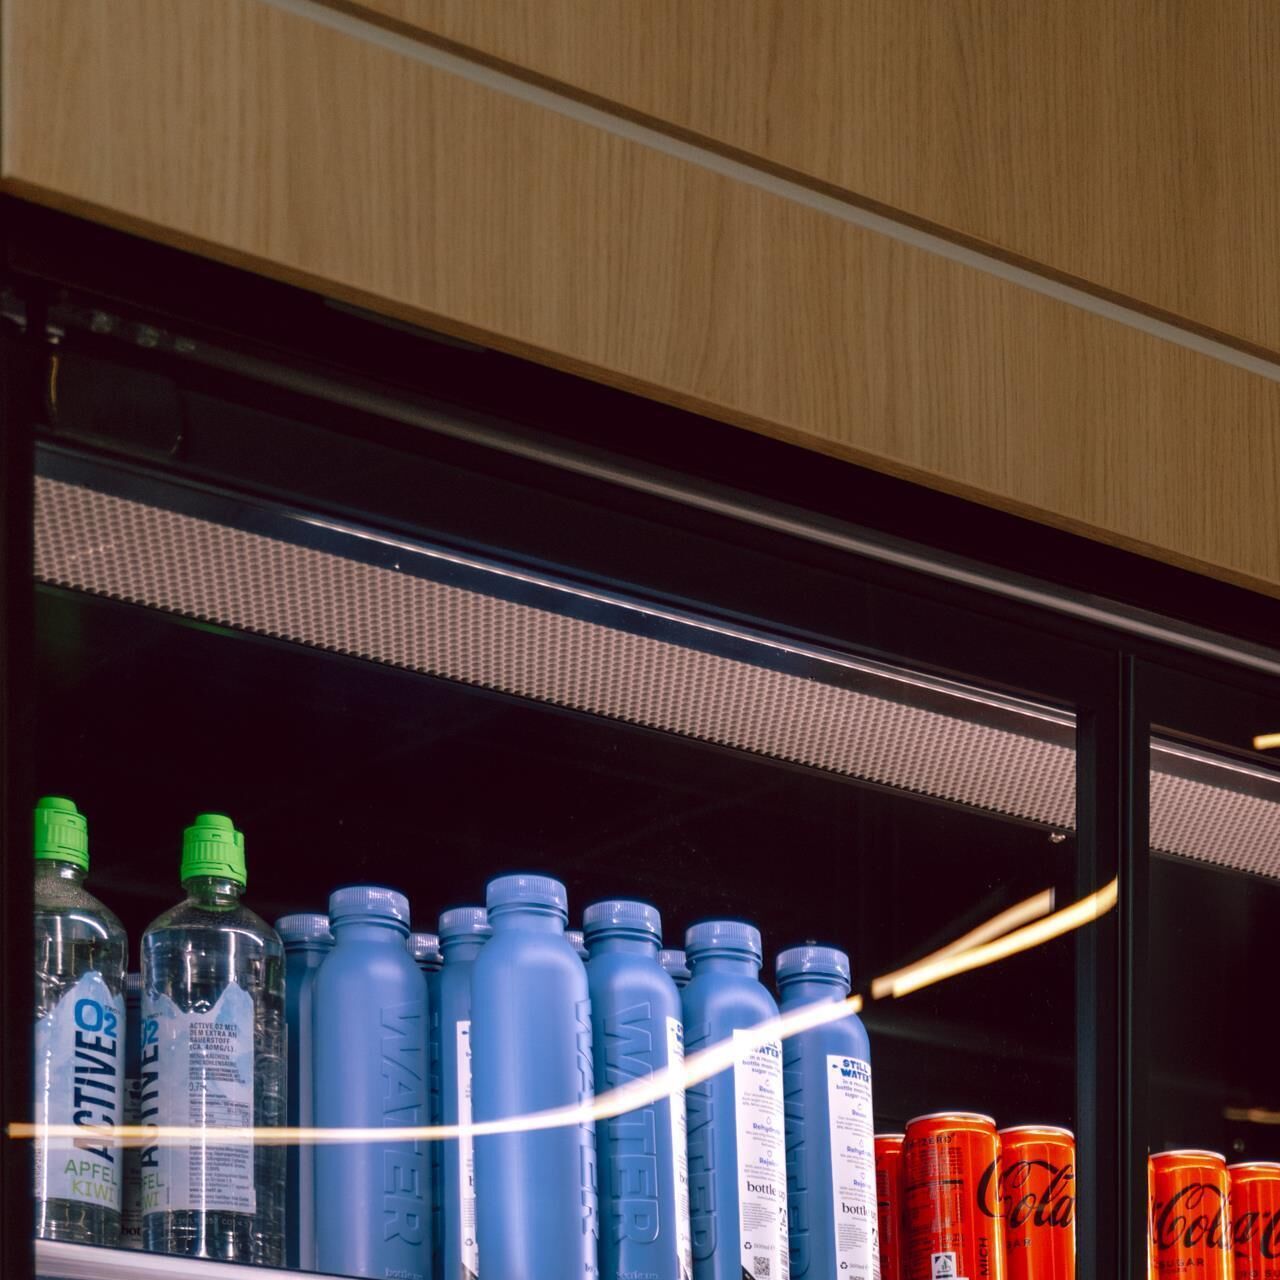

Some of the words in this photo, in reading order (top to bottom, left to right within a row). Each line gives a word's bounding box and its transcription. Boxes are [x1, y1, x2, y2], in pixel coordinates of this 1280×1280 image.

[64, 1159, 117, 1186] APFEL
[71, 1180, 114, 1202] KIWI
[746, 1181, 777, 1196] bottle
[979, 1237, 988, 1275] MICH
